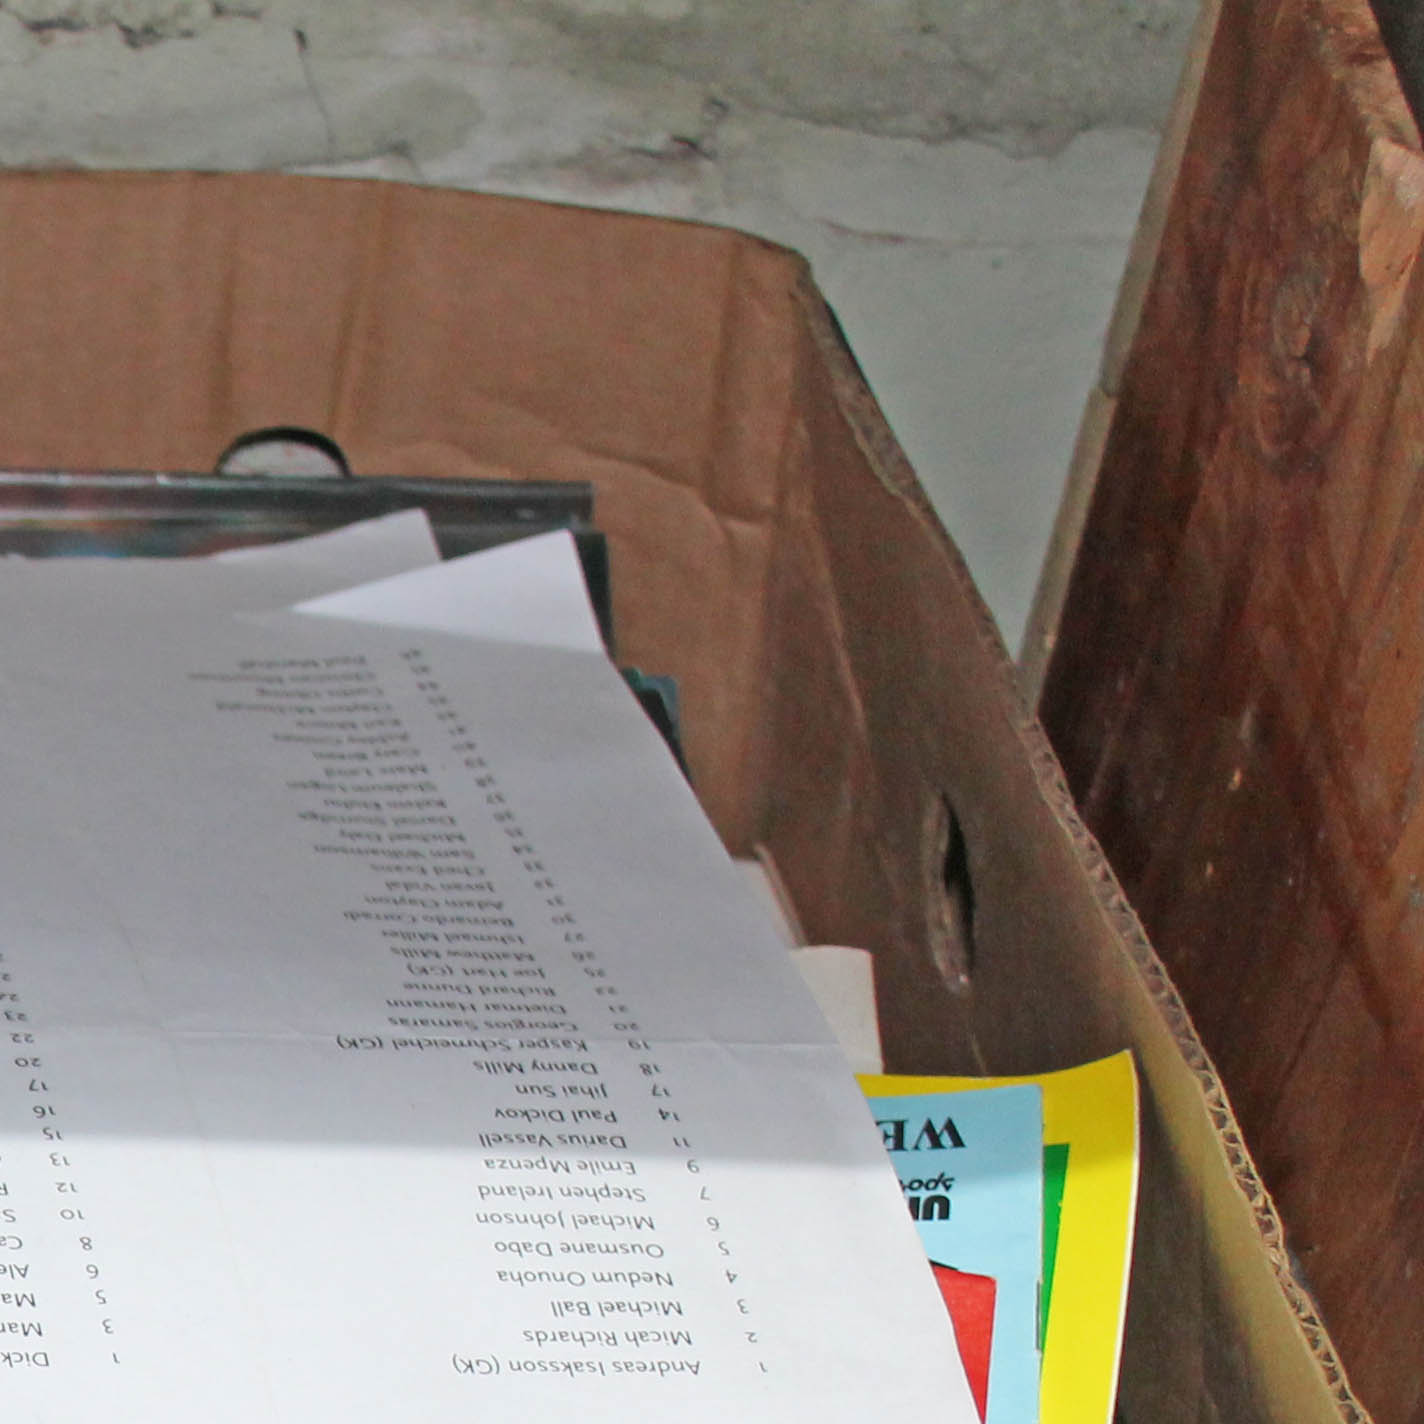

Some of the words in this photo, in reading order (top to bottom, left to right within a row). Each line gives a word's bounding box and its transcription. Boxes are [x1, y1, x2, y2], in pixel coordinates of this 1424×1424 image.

[29, 1078, 48, 1092] 17
[55, 1182, 78, 1193] 12
[478, 1183, 554, 1203] Ireland
[559, 1183, 646, 1203] Stephen
[60, 1209, 85, 1220] 10
[476, 1210, 565, 1231] Johnson
[572, 1210, 655, 1231] Michael
[79, 1236, 93, 1251] 8
[494, 1242, 553, 1258] Dabo
[560, 1242, 664, 1258] Ousmane
[86, 1264, 99, 1279] 6
[496, 1271, 586, 1288] Onuoha
[598, 1271, 674, 1288] Nedum
[95, 1289, 107, 1304] 5
[550, 1301, 591, 1317] Ball
[597, 1301, 683, 1318] Michael
[102, 1318, 114, 1334] 3
[523, 1330, 618, 1348] Richards
[624, 1331, 692, 1348] Micah
[0, 1352, 49, 1368] Dick
[452, 1353, 500, 1375] (GK)
[612, 1360, 700, 1377] Andreas
[509, 1360, 606, 1378] Isaksson
